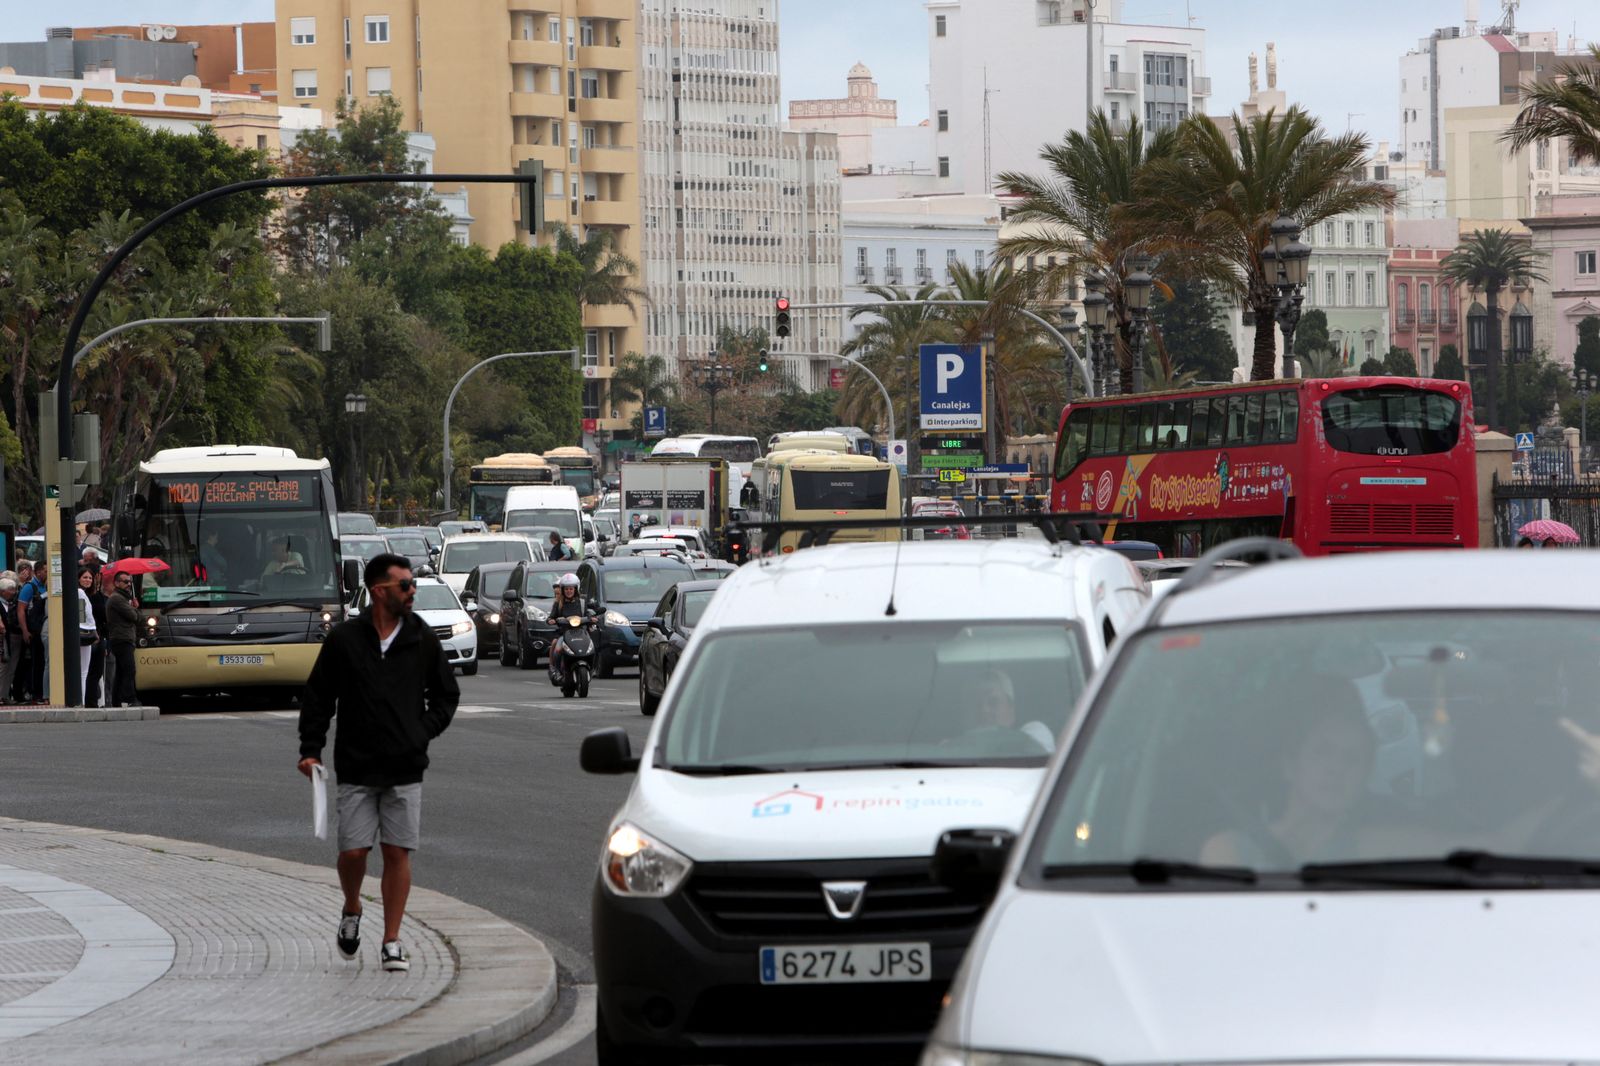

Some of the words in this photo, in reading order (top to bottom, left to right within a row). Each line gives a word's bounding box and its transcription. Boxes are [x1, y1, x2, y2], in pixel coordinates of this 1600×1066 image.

[936, 353, 965, 394] P
[931, 401, 971, 410] Canalejas
[649, 410, 659, 425] P
[934, 418, 978, 426] Interparking
[941, 472, 952, 481] 14
[206, 482, 236, 492] CADIZ
[249, 480, 298, 491] CHICLANA
[206, 492, 256, 502] CHICLANA
[268, 490, 299, 500] CADIZ
[224, 656, 244, 664] 3533
[782, 951, 857, 978] 6274
[870, 949, 924, 976] JPS
